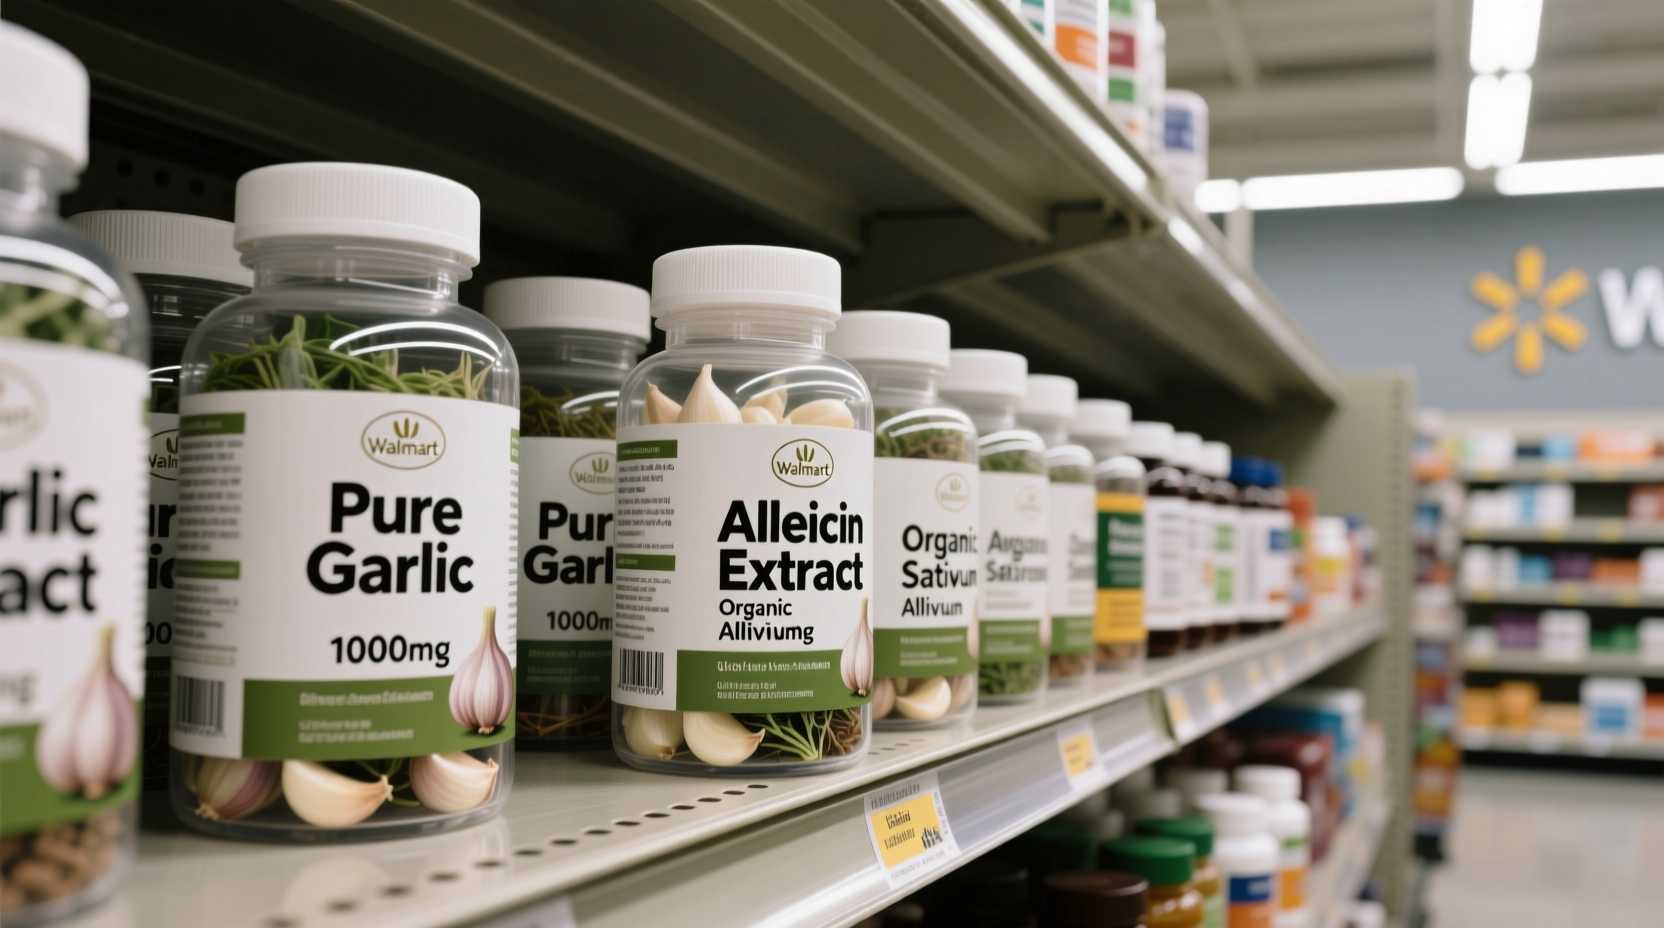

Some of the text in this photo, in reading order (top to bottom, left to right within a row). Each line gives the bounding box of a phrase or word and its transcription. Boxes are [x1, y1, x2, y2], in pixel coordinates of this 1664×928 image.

[368, 437, 438, 456] Walmart
[776, 461, 830, 476] Walmart
[330, 482, 463, 535] Pure
[717, 500, 863, 544] Alleicin
[306, 541, 475, 595] Garlic
[719, 549, 864, 591] Extract
[719, 598, 793, 620] Organic
[330, 635, 451, 668] 1000mg
